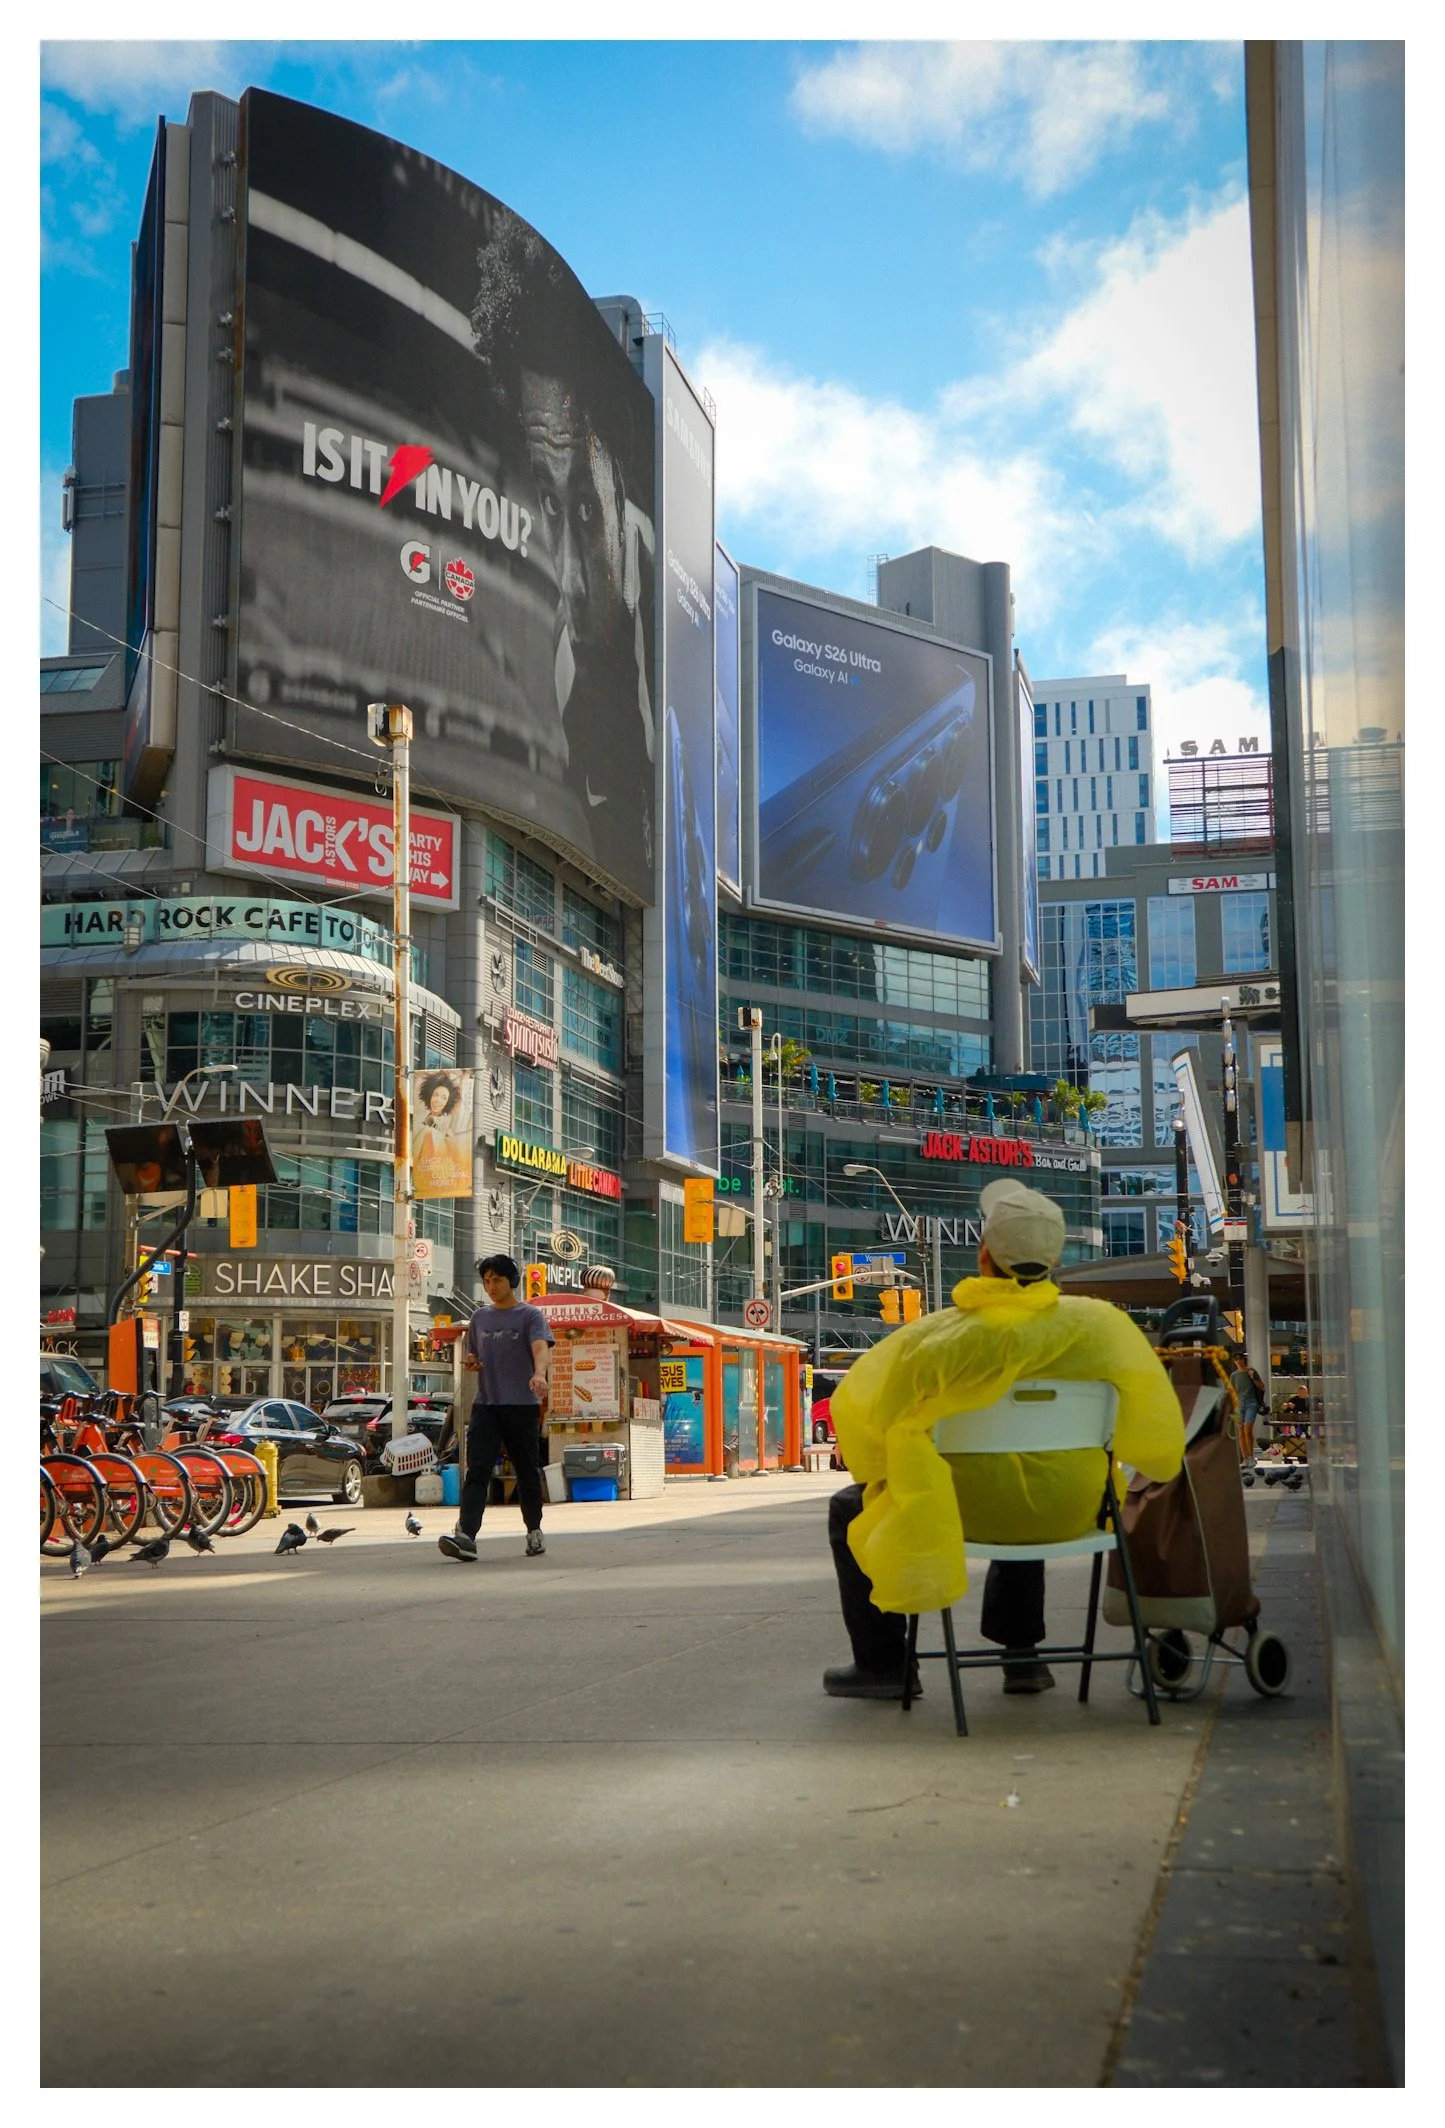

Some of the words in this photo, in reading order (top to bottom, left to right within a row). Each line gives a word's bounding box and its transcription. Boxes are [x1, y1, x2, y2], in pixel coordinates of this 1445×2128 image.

[303, 421, 346, 483] IS
[350, 435, 388, 495] IT
[415, 463, 452, 521] IN
[456, 473, 532, 558] YOU?
[445, 571, 475, 588] CANADA
[411, 597, 446, 614] PARTENAIRE
[445, 609, 470, 623] OFFICIEL
[414, 590, 441, 604] OFFICIAL
[440, 599, 466, 613] PARTNER
[771, 629, 823, 660] Galaxy
[824, 644, 848, 664] S26
[849, 651, 881, 673] Ultra
[793, 658, 836, 685] Galaxy
[837, 670, 848, 685] AI
[1180, 736, 1260, 756] SAM
[325, 815, 337, 868] ASTORS
[409, 831, 442, 851] ARTY
[409, 850, 432, 867] HIS
[1191, 876, 1239, 890] SAM
[64, 909, 147, 935] HARD
[155, 906, 237, 930] ROCK
[244, 906, 318, 935] CAFE
[234, 991, 371, 1020] CINEPLEX
[40, 1091, 59, 1105] OWL
[153, 1080, 395, 1125] WINNER
[502, 1134, 567, 1177] DOLLARAMA
[921, 1131, 964, 1162] JACK
[968, 1136, 1034, 1168] ASTOR'S
[1035, 1154, 1051, 1167] Bar
[1052, 1155, 1067, 1171] and
[1067, 1157, 1087, 1173] Grill
[718, 1176, 741, 1191] be
[885, 1212, 985, 1247] WINN
[215, 1262, 332, 1296] SHAKE
[338, 1264, 396, 1297] SHA
[546, 1262, 585, 1289] INEPL
[551, 1304, 599, 1315] DRINKS
[564, 1312, 623, 1322] SAUSAGES
[40, 1341, 79, 1357] ACK
[660, 1364, 684, 1377] SUS
[660, 1376, 684, 1389] AVES
